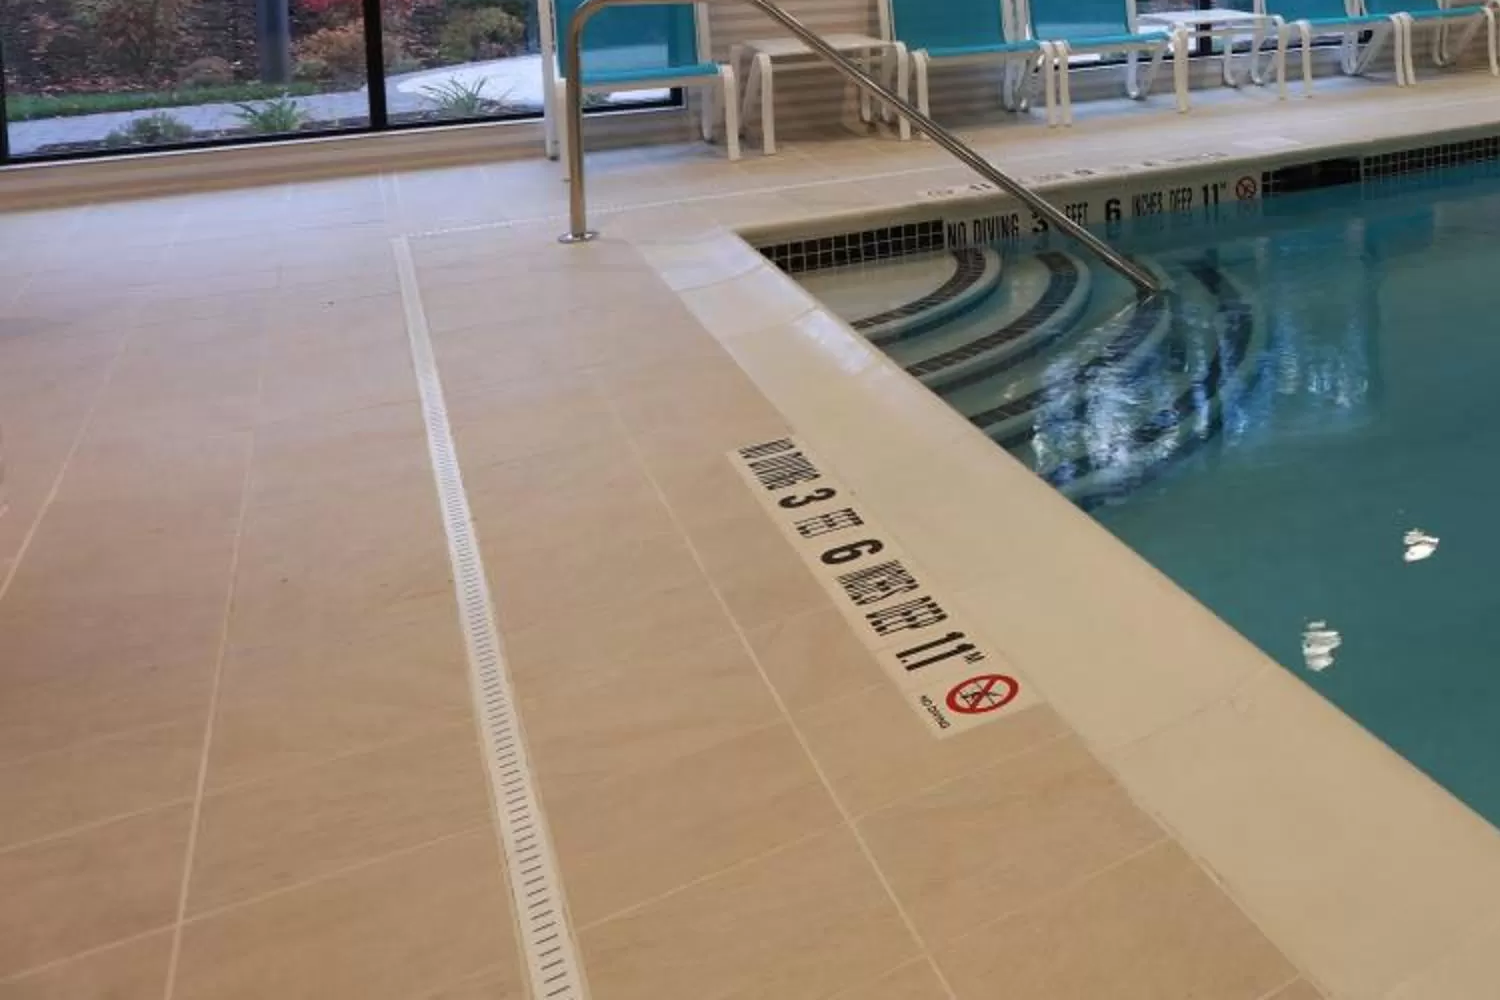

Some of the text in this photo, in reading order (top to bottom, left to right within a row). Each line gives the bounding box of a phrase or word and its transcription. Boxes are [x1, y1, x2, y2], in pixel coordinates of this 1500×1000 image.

[947, 221, 967, 248] NO
[973, 214, 1019, 245] DIVING
[1031, 210, 1049, 233] 3
[778, 488, 837, 508] 3
[793, 507, 864, 539] FEET
[821, 538, 884, 565] 6
[836, 559, 919, 606] INCHES
[865, 595, 949, 637] DEEP
